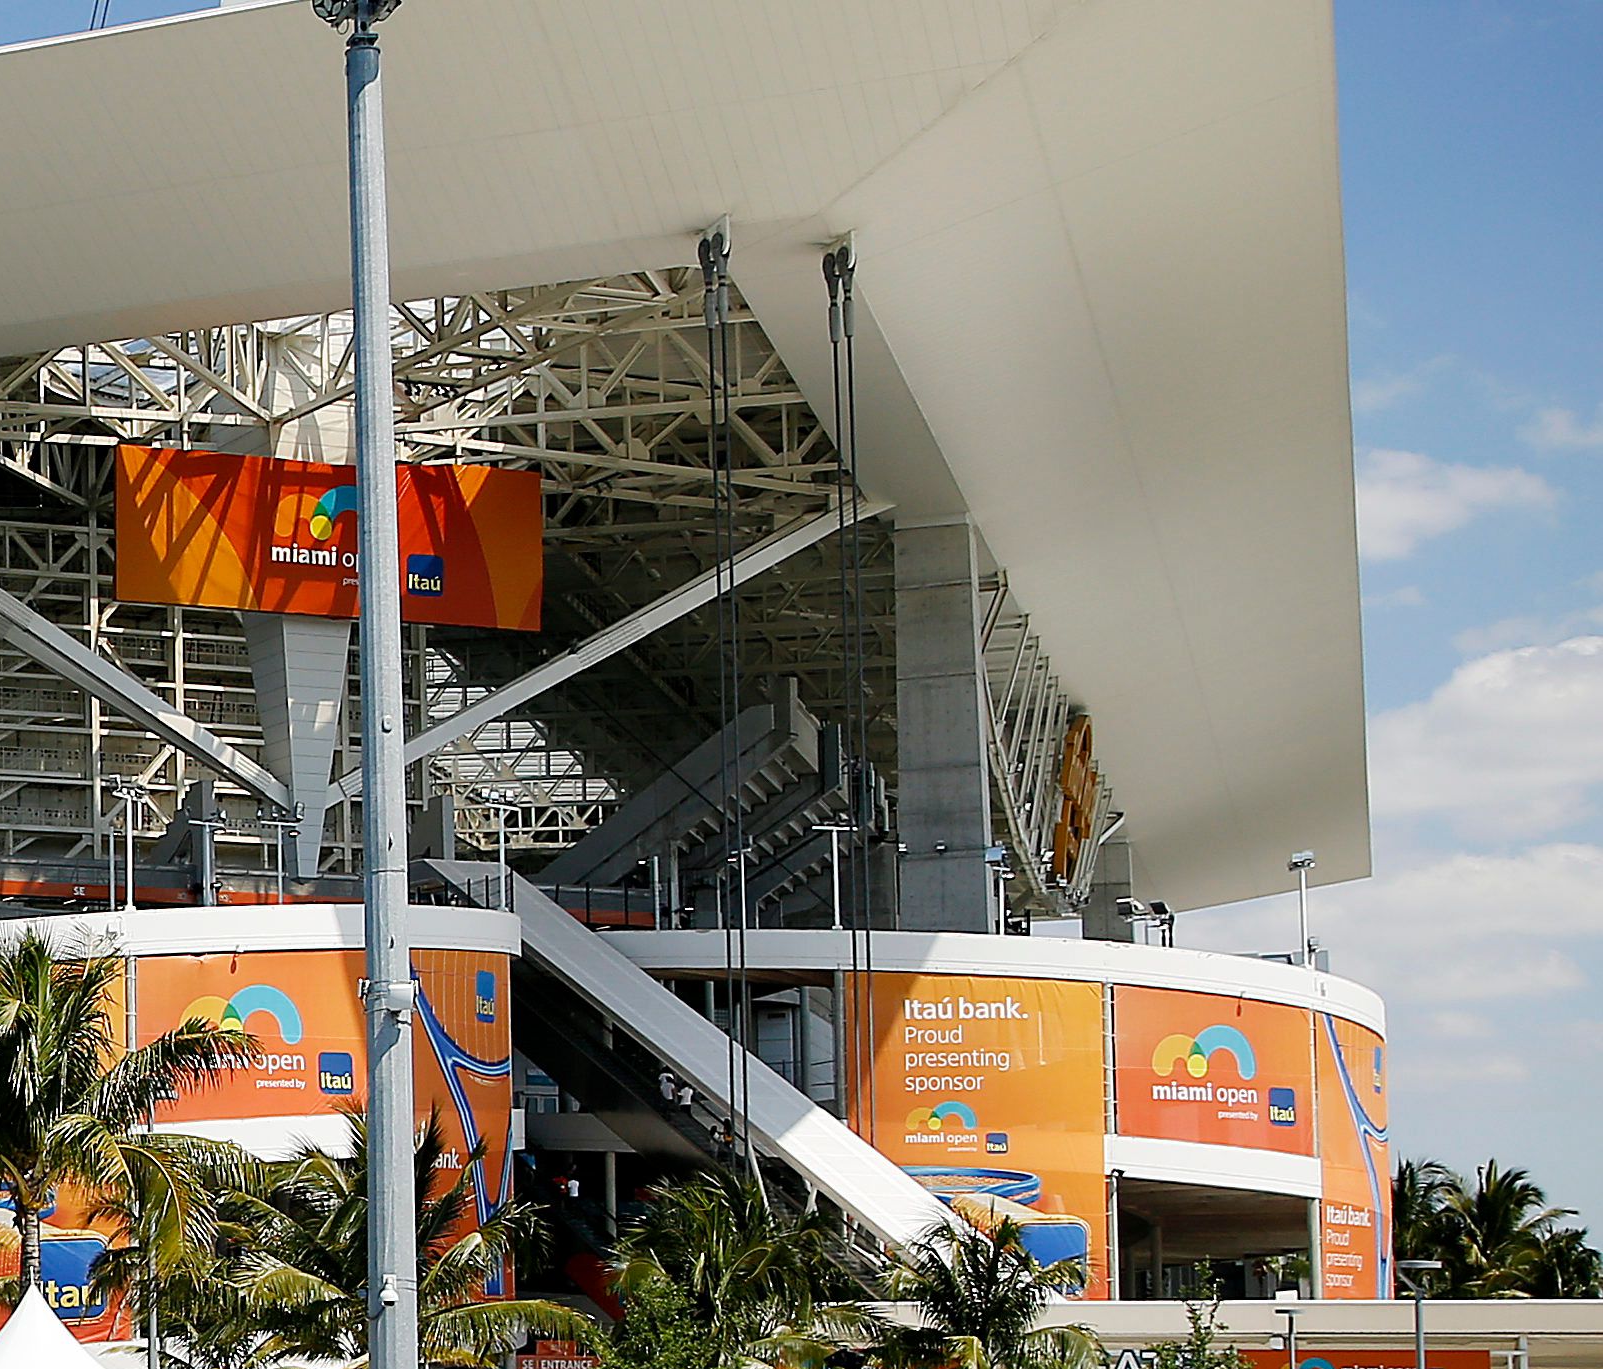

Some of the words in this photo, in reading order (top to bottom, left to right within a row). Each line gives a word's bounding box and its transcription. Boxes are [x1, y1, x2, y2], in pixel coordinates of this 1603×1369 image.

[271, 542, 337, 566] miami
[408, 573, 441, 592] Itaú
[476, 994, 495, 1016] Itaú
[904, 996, 953, 1020] Itaú
[959, 996, 1029, 1020] bank.
[905, 1024, 963, 1044] Proud
[905, 1049, 1010, 1072] presenting
[256, 1078, 294, 1090] presented
[320, 1071, 352, 1090] Itaú
[905, 1075, 984, 1094] sponsor
[1152, 1080, 1213, 1102] miami
[1216, 1087, 1258, 1108] open
[1269, 1105, 1295, 1122] Itaú
[905, 1132, 944, 1144] miami
[946, 1133, 978, 1146] open
[431, 1147, 463, 1169] ank.
[1326, 1204, 1348, 1226] Itaú
[1326, 1230, 1349, 1247] Proud
[1325, 1252, 1363, 1271] presenting
[1325, 1273, 1354, 1288] sponsor
[522, 1359, 534, 1369] SE
